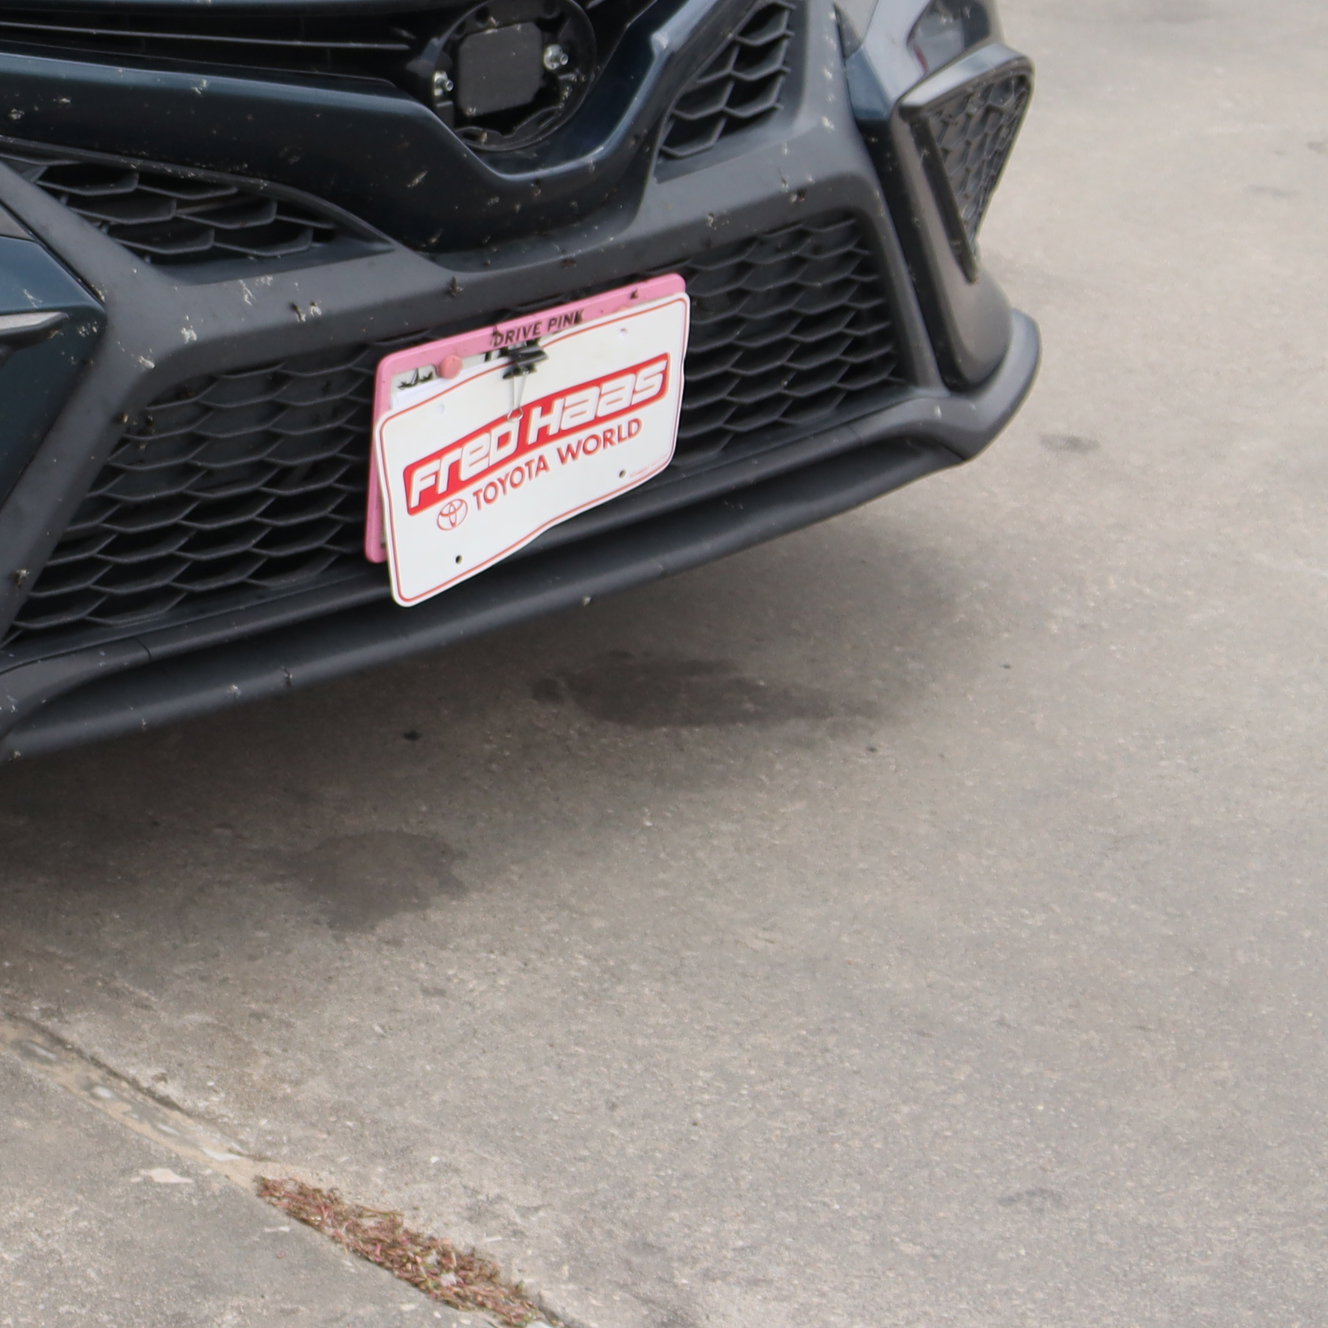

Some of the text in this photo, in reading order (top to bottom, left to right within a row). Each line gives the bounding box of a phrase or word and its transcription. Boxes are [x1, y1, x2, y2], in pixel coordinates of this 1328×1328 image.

[493, 309, 585, 347] DRIVE PINK
[472, 417, 643, 511] TOYOTA WORLD
